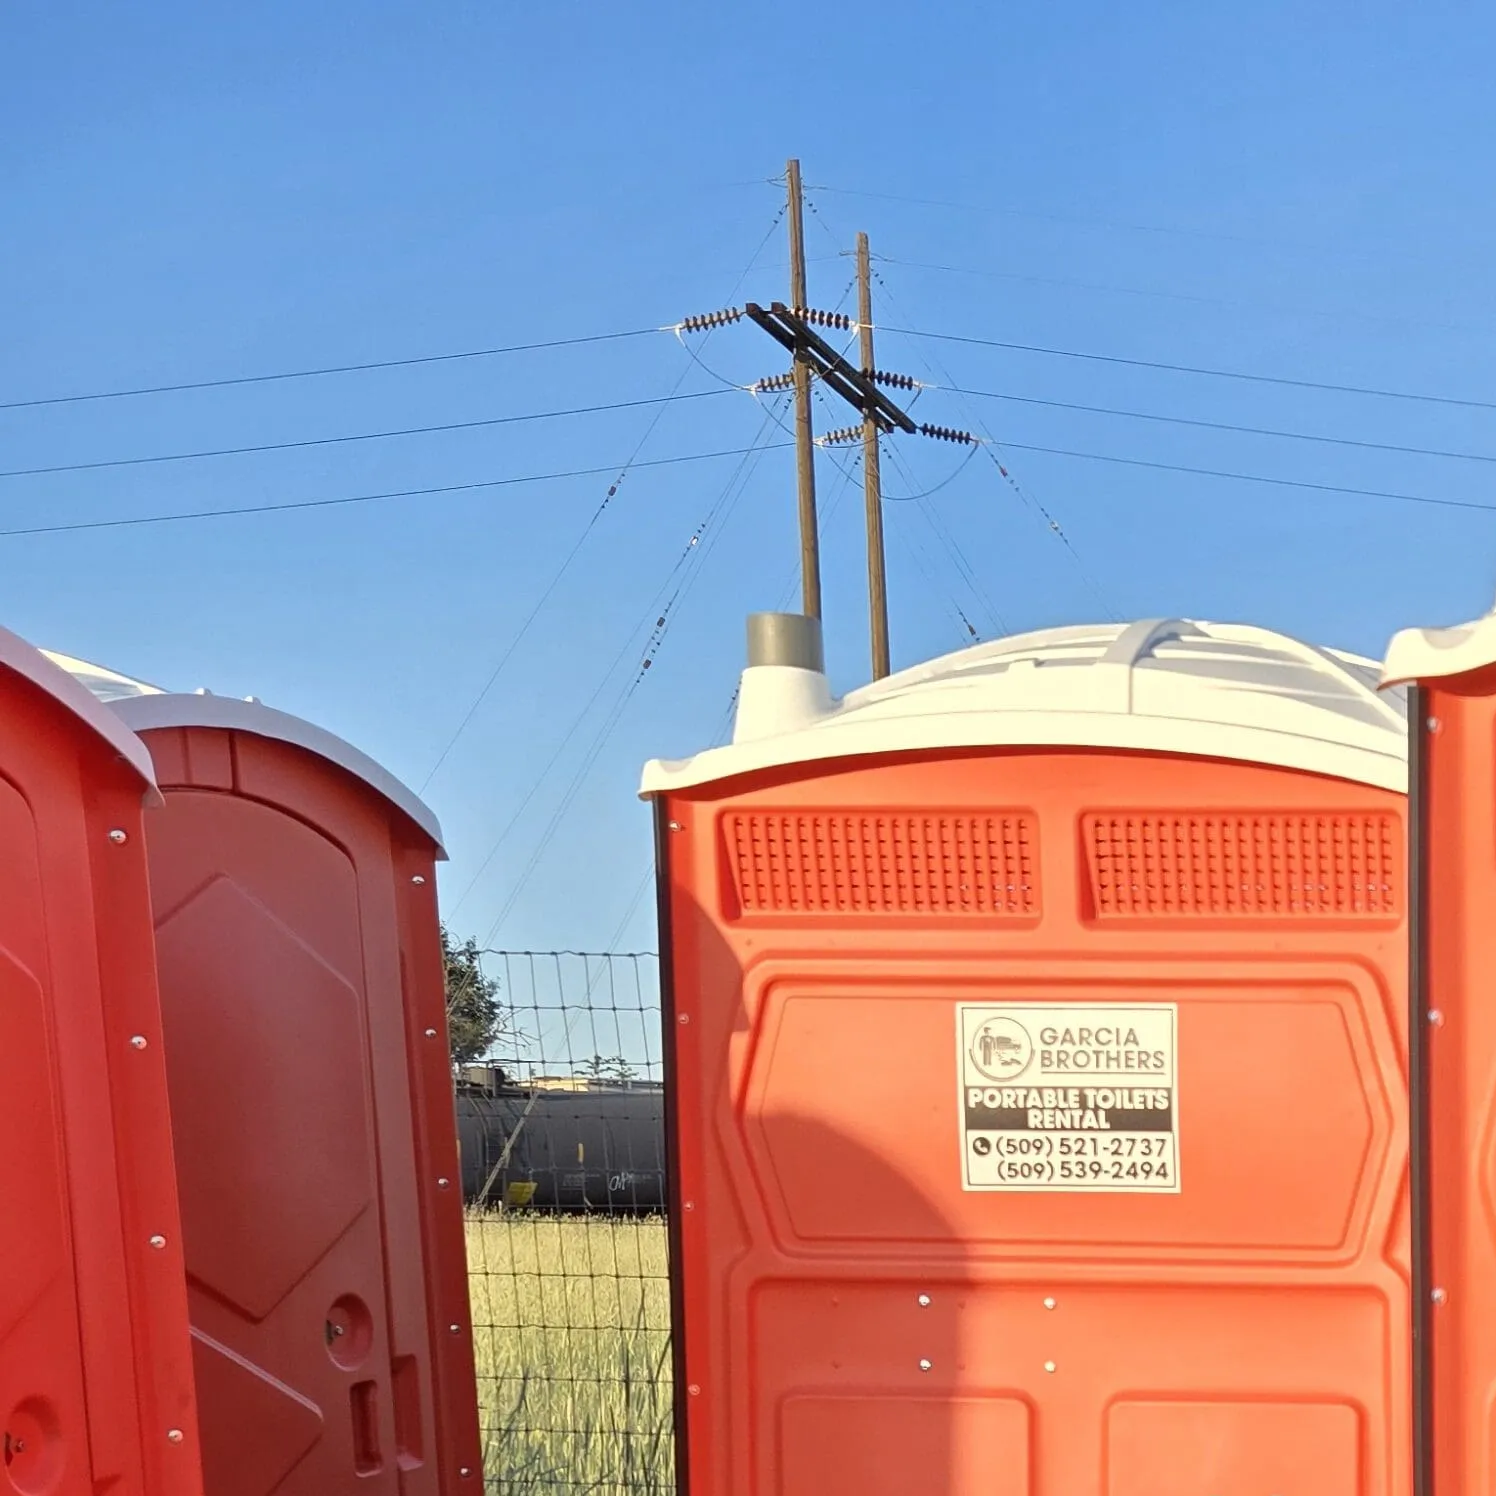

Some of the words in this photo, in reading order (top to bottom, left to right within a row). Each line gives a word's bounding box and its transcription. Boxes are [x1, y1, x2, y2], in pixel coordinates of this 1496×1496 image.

[1039, 1026, 1140, 1047] GARCIA
[1040, 1049, 1165, 1069] BROTHERS
[968, 1088, 1080, 1109] PORTABLE
[1084, 1088, 1169, 1110] TOILETS
[1027, 1109, 1111, 1129] RENTAL
[996, 1136, 1053, 1157] (509)
[1059, 1137, 1167, 1156] 521-2737
[997, 1160, 1054, 1181] (509)
[1060, 1161, 1169, 1180] 539-2494
